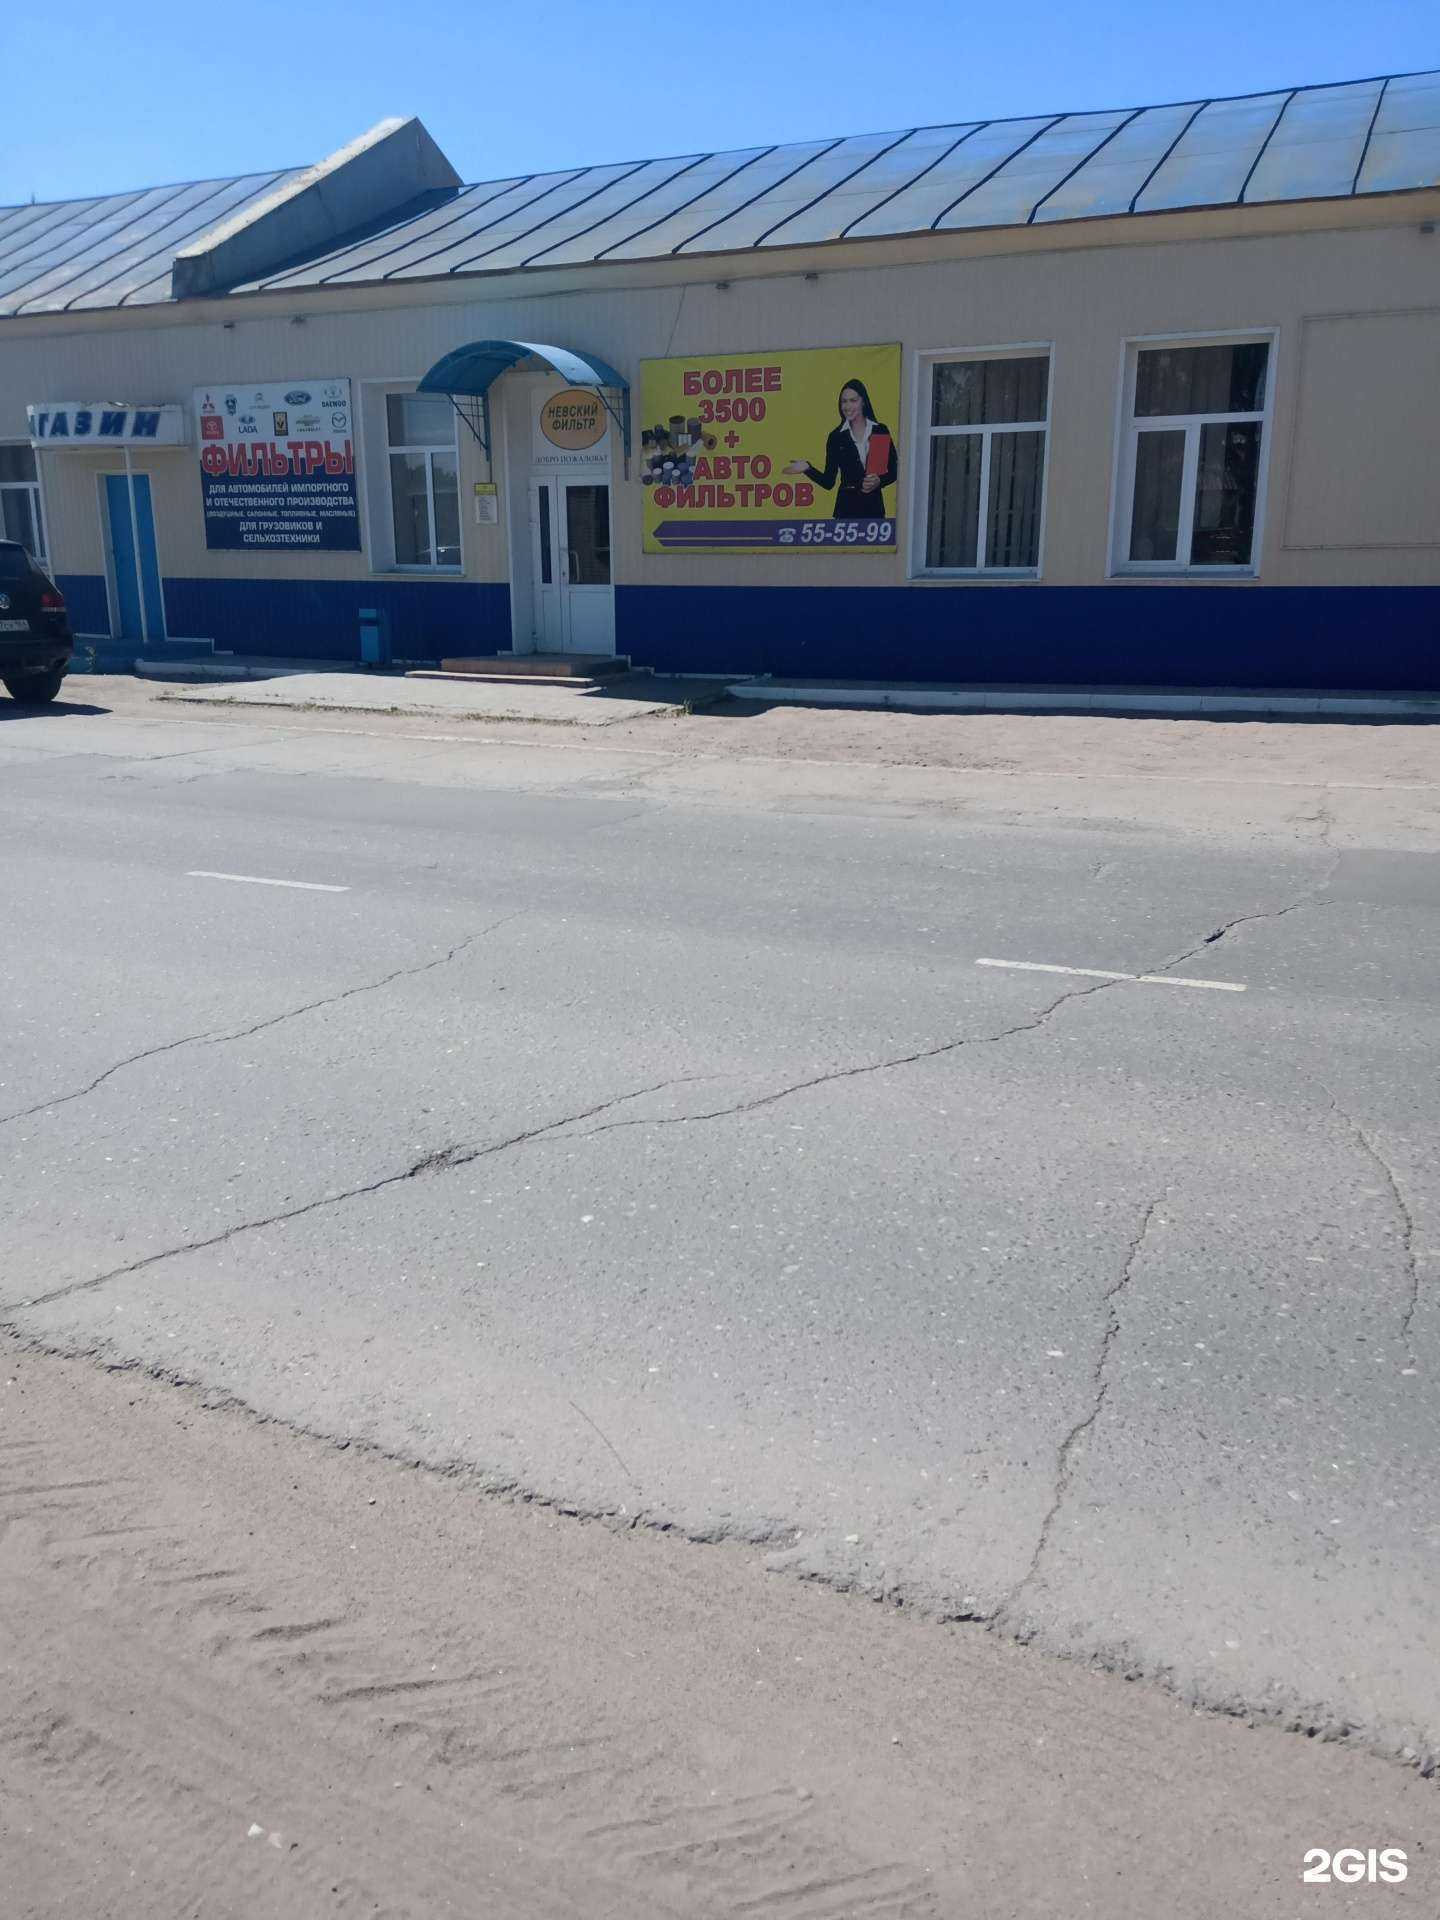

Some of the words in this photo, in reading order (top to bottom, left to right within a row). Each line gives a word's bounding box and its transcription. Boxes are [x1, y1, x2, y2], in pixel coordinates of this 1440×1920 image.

[683, 366, 782, 396] БОЛЕЕ
[548, 400, 598, 418] НЕВСКИЙ
[699, 397, 767, 424] 3500
[30, 411, 161, 437] ГАЗИН
[238, 425, 258, 434] LADA
[552, 418, 596, 431] ФИЛЬТР
[201, 439, 354, 476] ФИЛЬТРЫ
[692, 454, 772, 481] АВТО
[209, 484, 226, 494] ДЛЯ
[228, 482, 289, 494] АВТОМОБИЛЕЙ
[291, 483, 349, 493] ИМПОРТНОГО
[653, 482, 815, 509] ФИЛЬТРОВ
[206, 498, 212, 506] И
[214, 497, 285, 507] ОТЕЧЕСТВЕННОГО
[287, 497, 355, 507] ПРОИЗВОДСТВА
[239, 521, 257, 532] ДЛЯ
[259, 521, 314, 531] ГРУЗОВИКОВ
[316, 521, 323, 530] И
[800, 521, 893, 543] 55-55-99
[243, 533, 321, 543] СЕЛЬХОЗТЕХНИКИ
